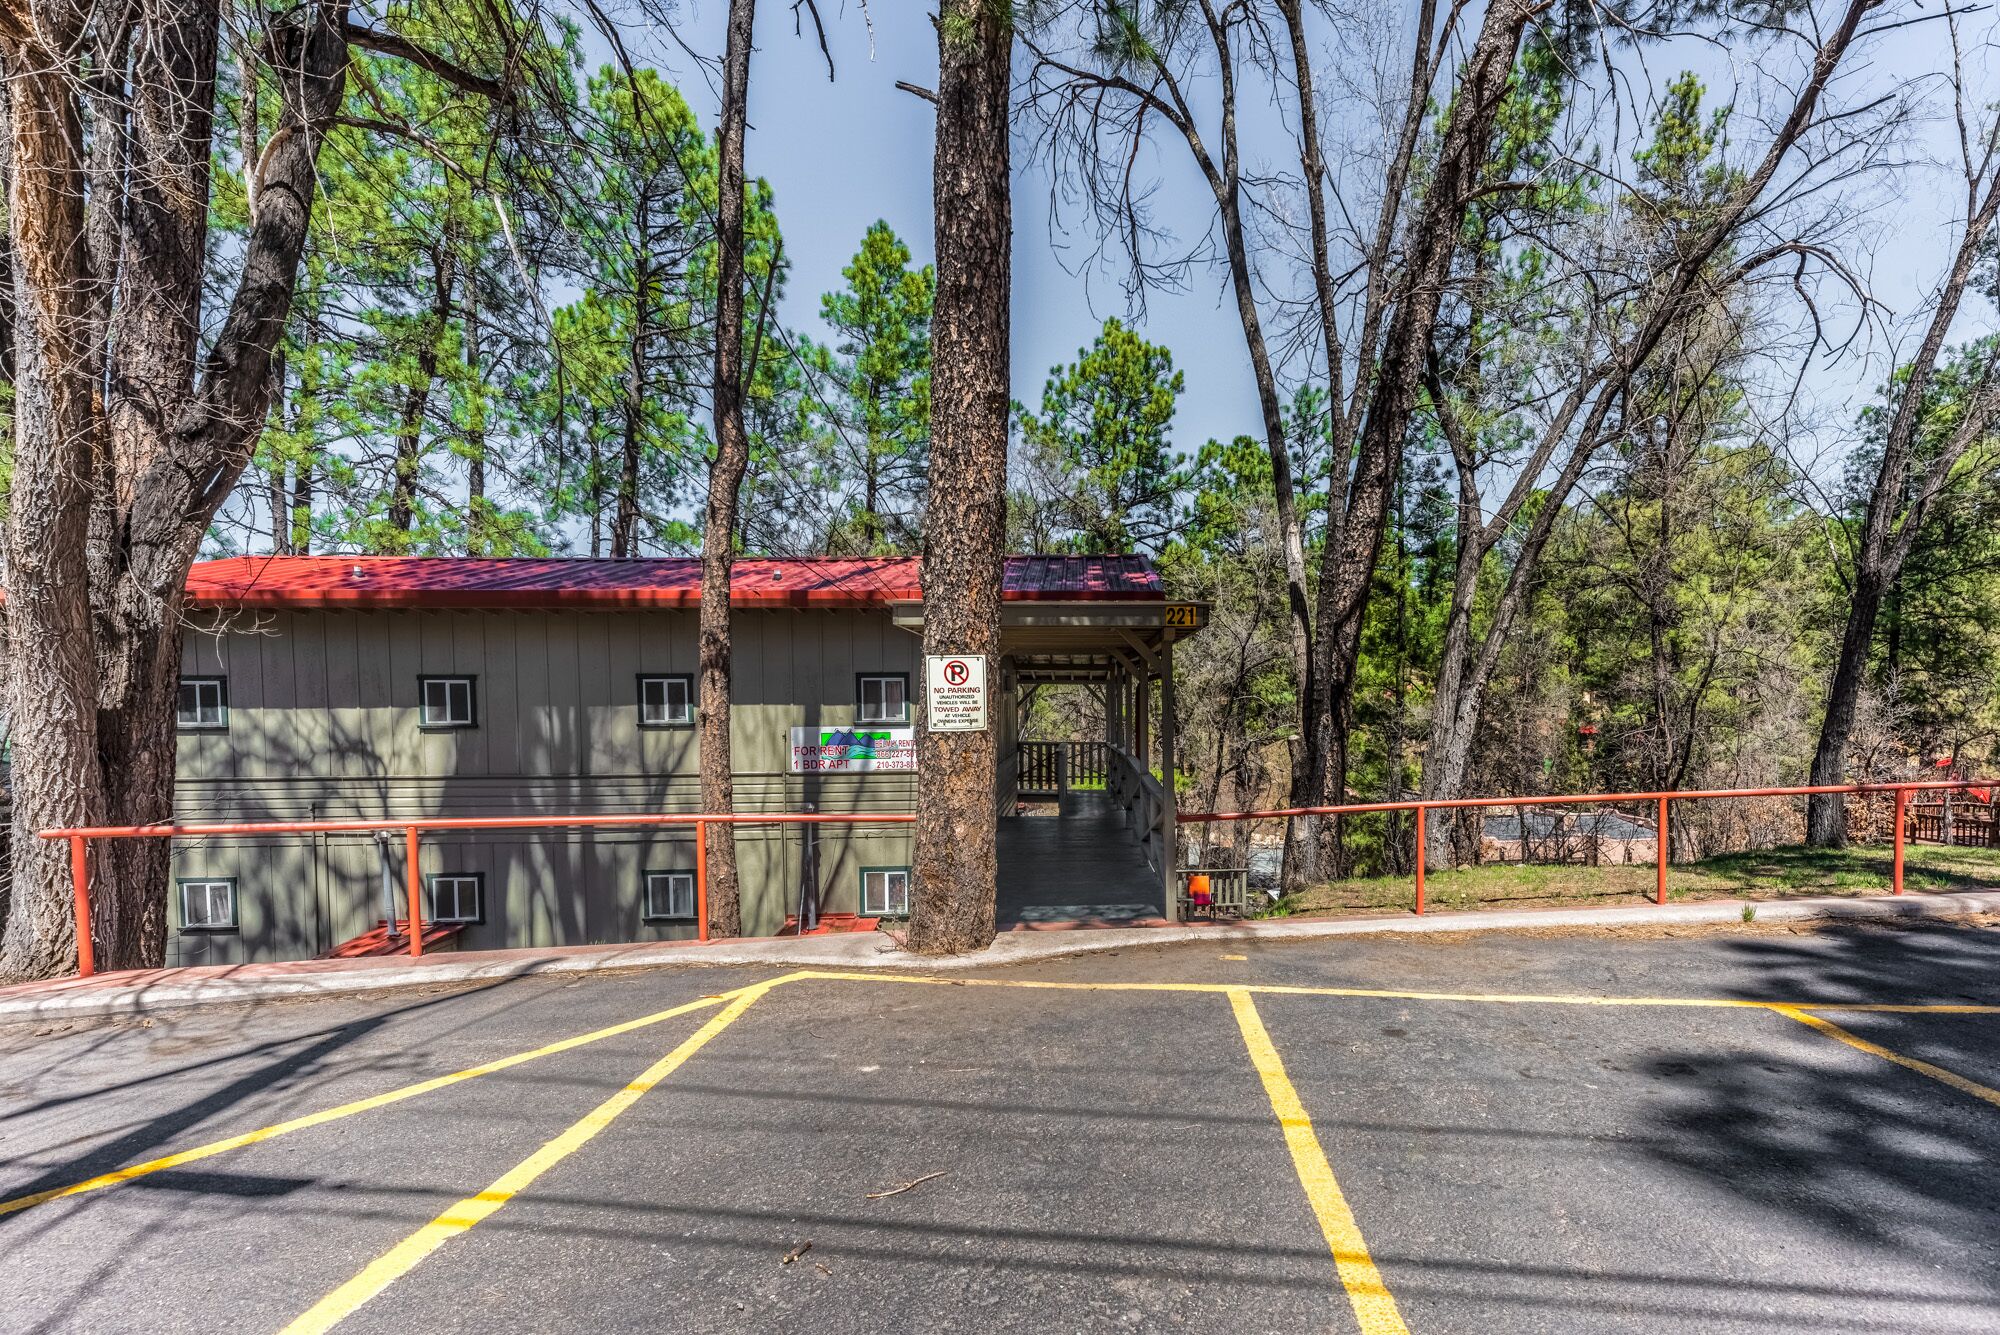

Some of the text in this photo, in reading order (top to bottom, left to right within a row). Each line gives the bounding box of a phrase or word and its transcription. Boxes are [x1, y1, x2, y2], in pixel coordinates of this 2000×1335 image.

[1167, 607, 1194, 625] 221
[947, 686, 981, 694] PARKING
[794, 745, 849, 756] FOR RENT
[794, 759, 850, 770] 1 BDR APT
